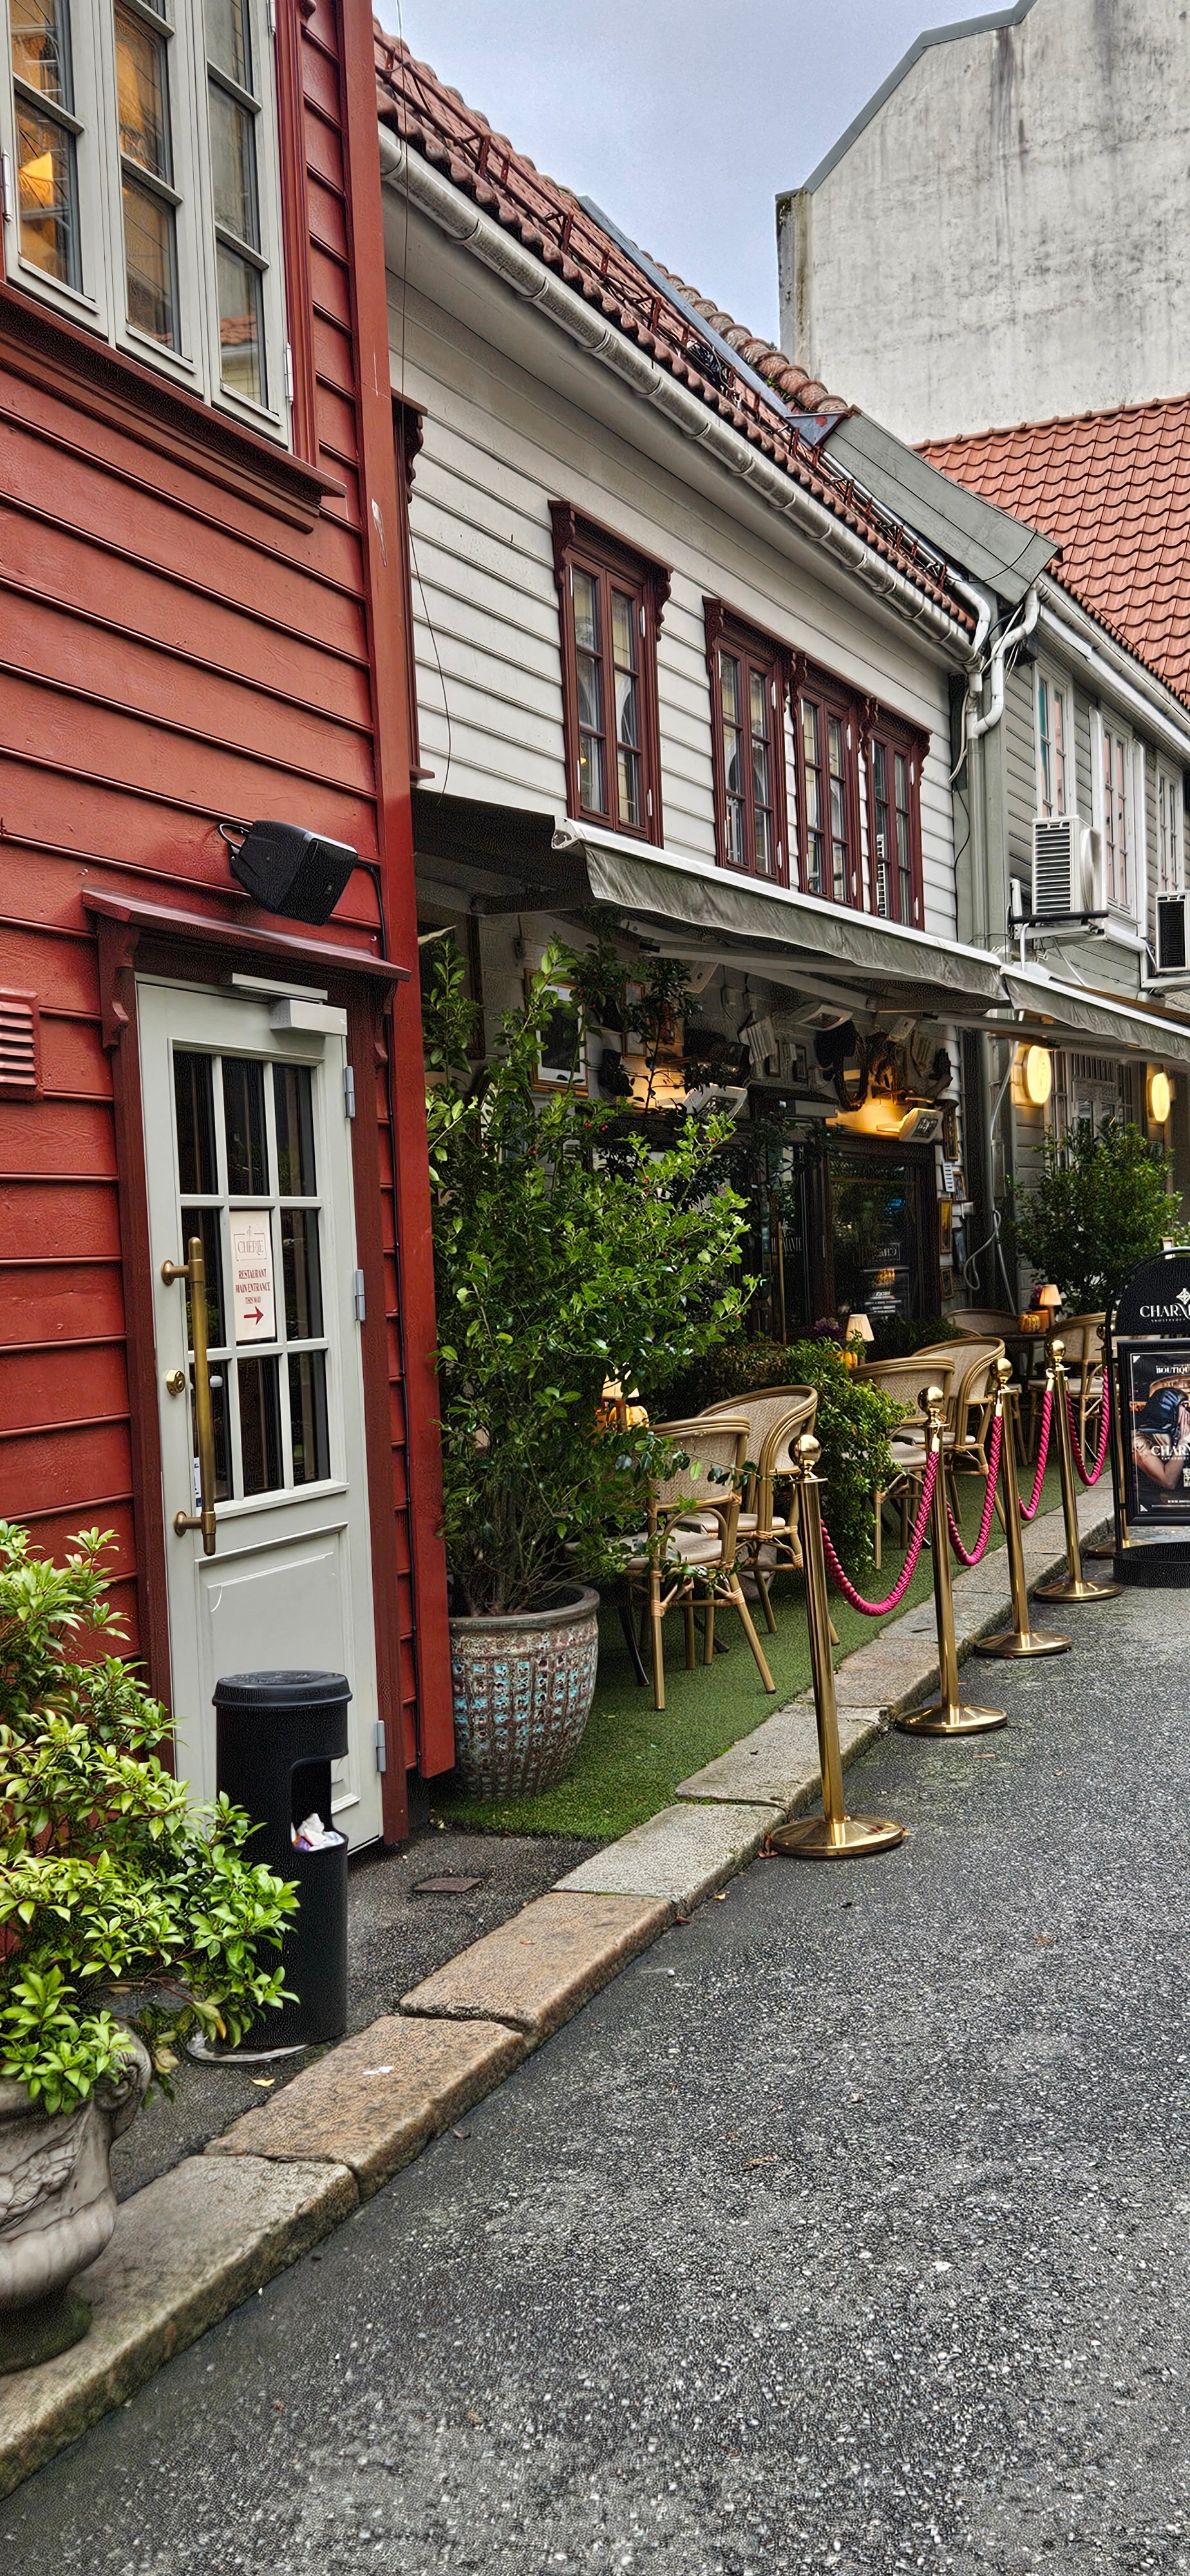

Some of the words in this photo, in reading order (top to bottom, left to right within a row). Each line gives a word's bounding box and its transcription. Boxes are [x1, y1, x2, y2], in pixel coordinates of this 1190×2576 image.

[238, 1269, 267, 1279] RESTAURANT
[235, 1284, 247, 1293] MAIN
[248, 1282, 270, 1293] ENTRANCE
